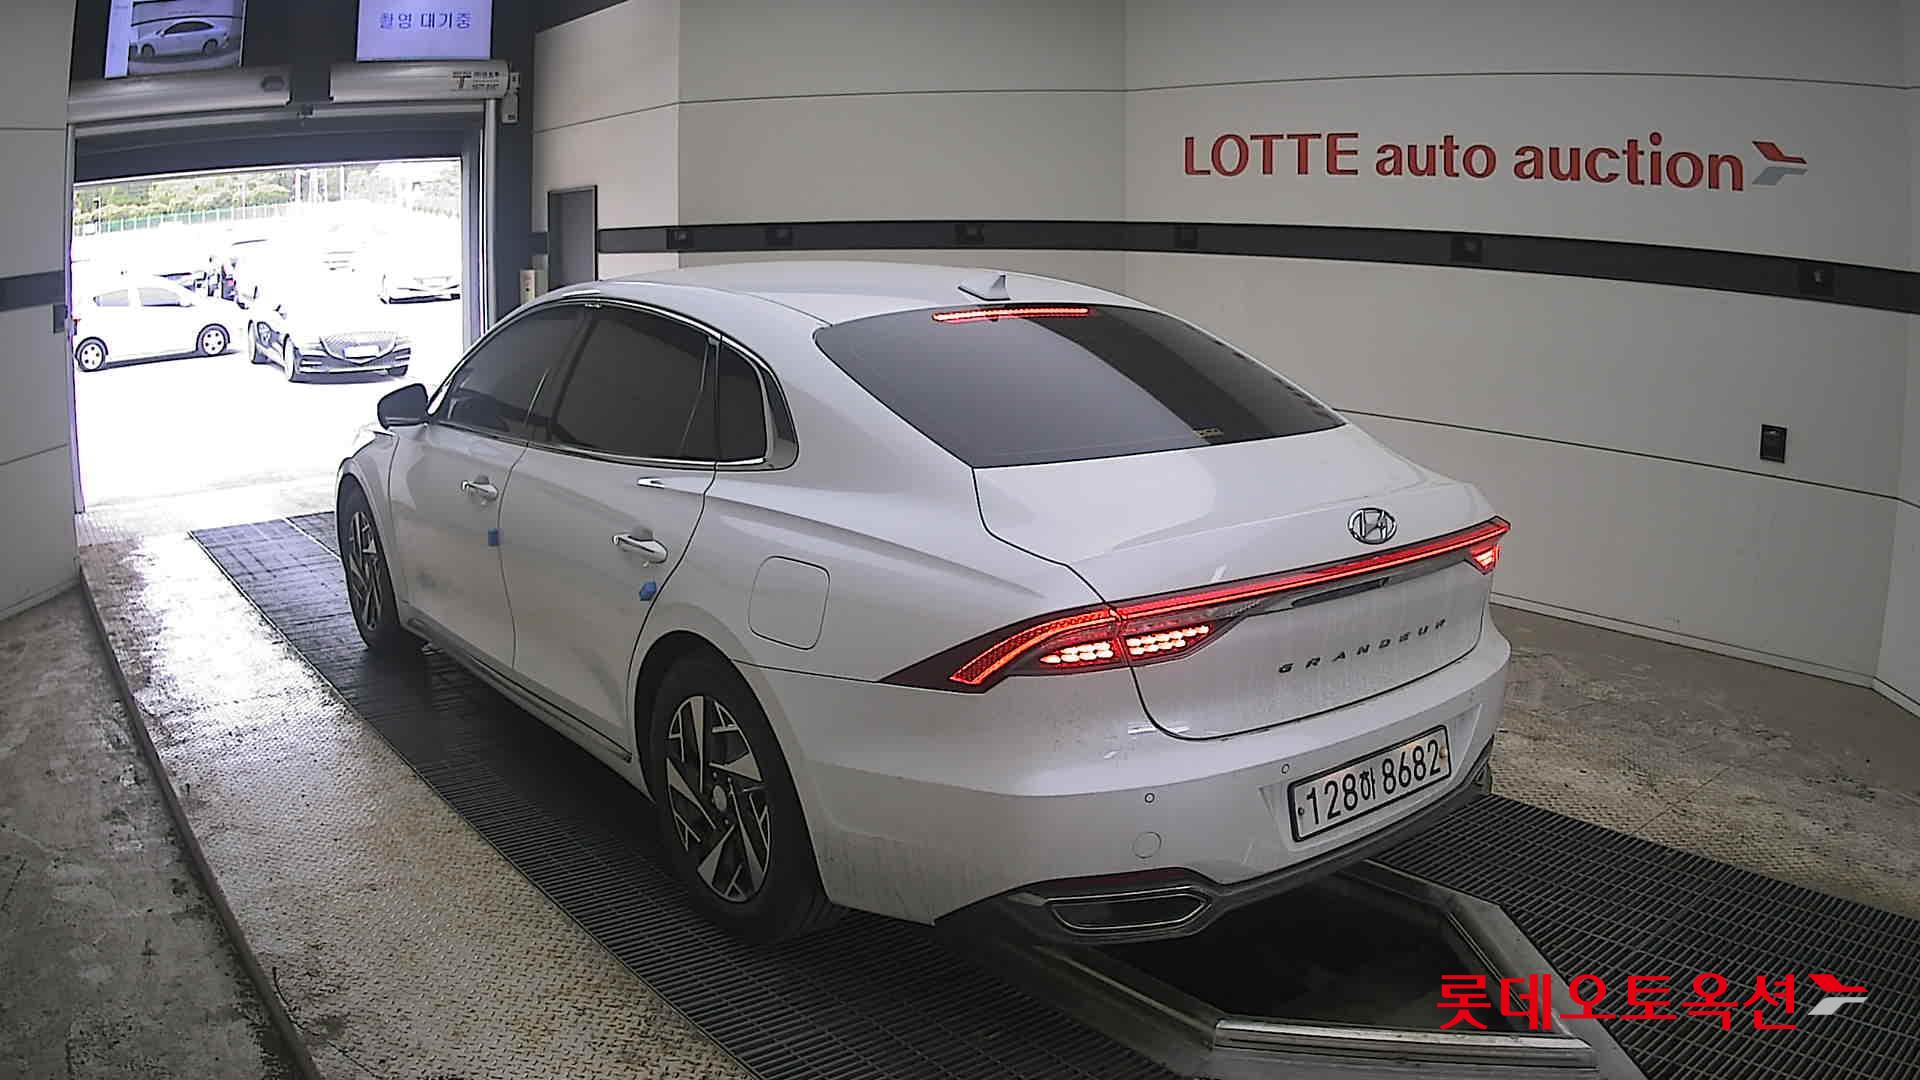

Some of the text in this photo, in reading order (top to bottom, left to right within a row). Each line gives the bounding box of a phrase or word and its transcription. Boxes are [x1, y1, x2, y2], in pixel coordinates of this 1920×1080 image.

[420, 12, 471, 29] 대기중
[1183, 131, 1744, 191] LOTTE auto auction
[1278, 618, 1446, 673] GRANDEUR
[1306, 739, 1441, 825] 128하 8682
